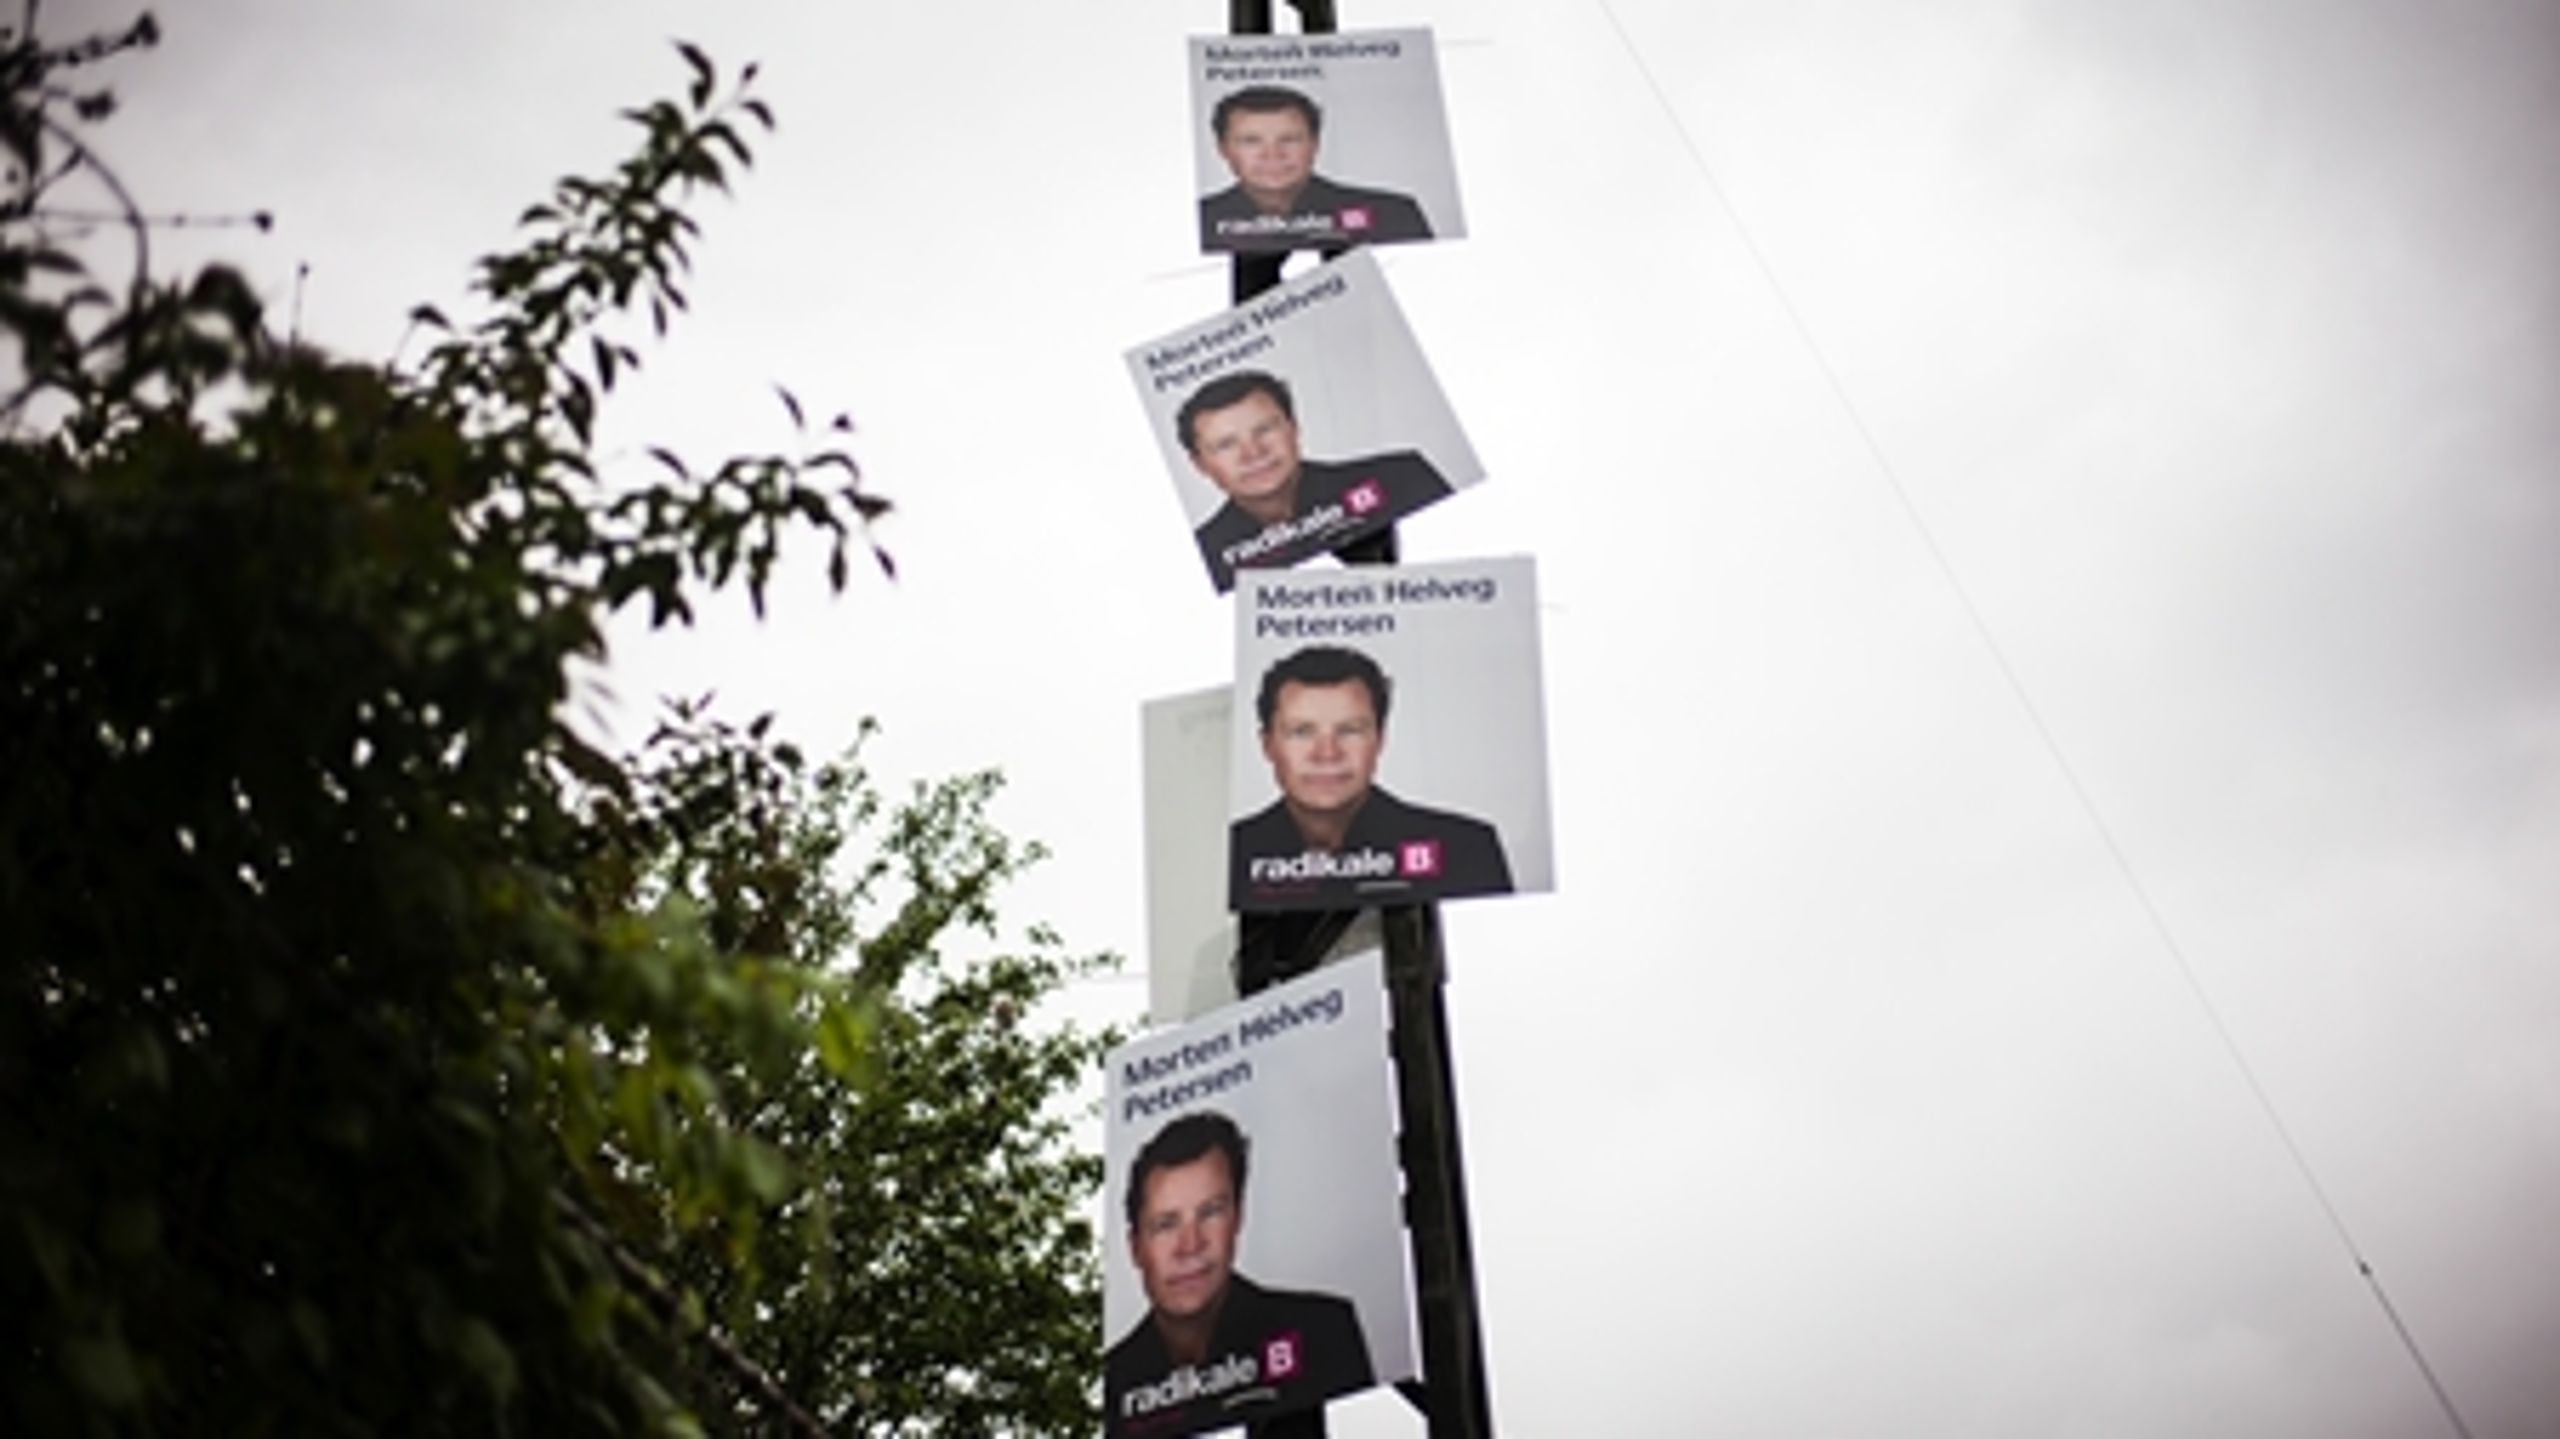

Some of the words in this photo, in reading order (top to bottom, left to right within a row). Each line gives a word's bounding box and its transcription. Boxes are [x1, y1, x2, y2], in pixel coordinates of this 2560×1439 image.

[1145, 318, 1247, 370] Morten
[1152, 334, 1275, 392] Petersen
[1255, 584, 1374, 609] Morten
[1382, 576, 1497, 604] Helveg
[1256, 614, 1396, 637] Petersen
[1250, 847, 1394, 880] radikale
[1404, 844, 1435, 872] B
[1122, 1031, 1233, 1088] Morten
[1238, 987, 1345, 1047] Helveg
[1123, 1060, 1254, 1122] Petersen
[1122, 1352, 1259, 1418] radikale
[1266, 1340, 1295, 1376] B
